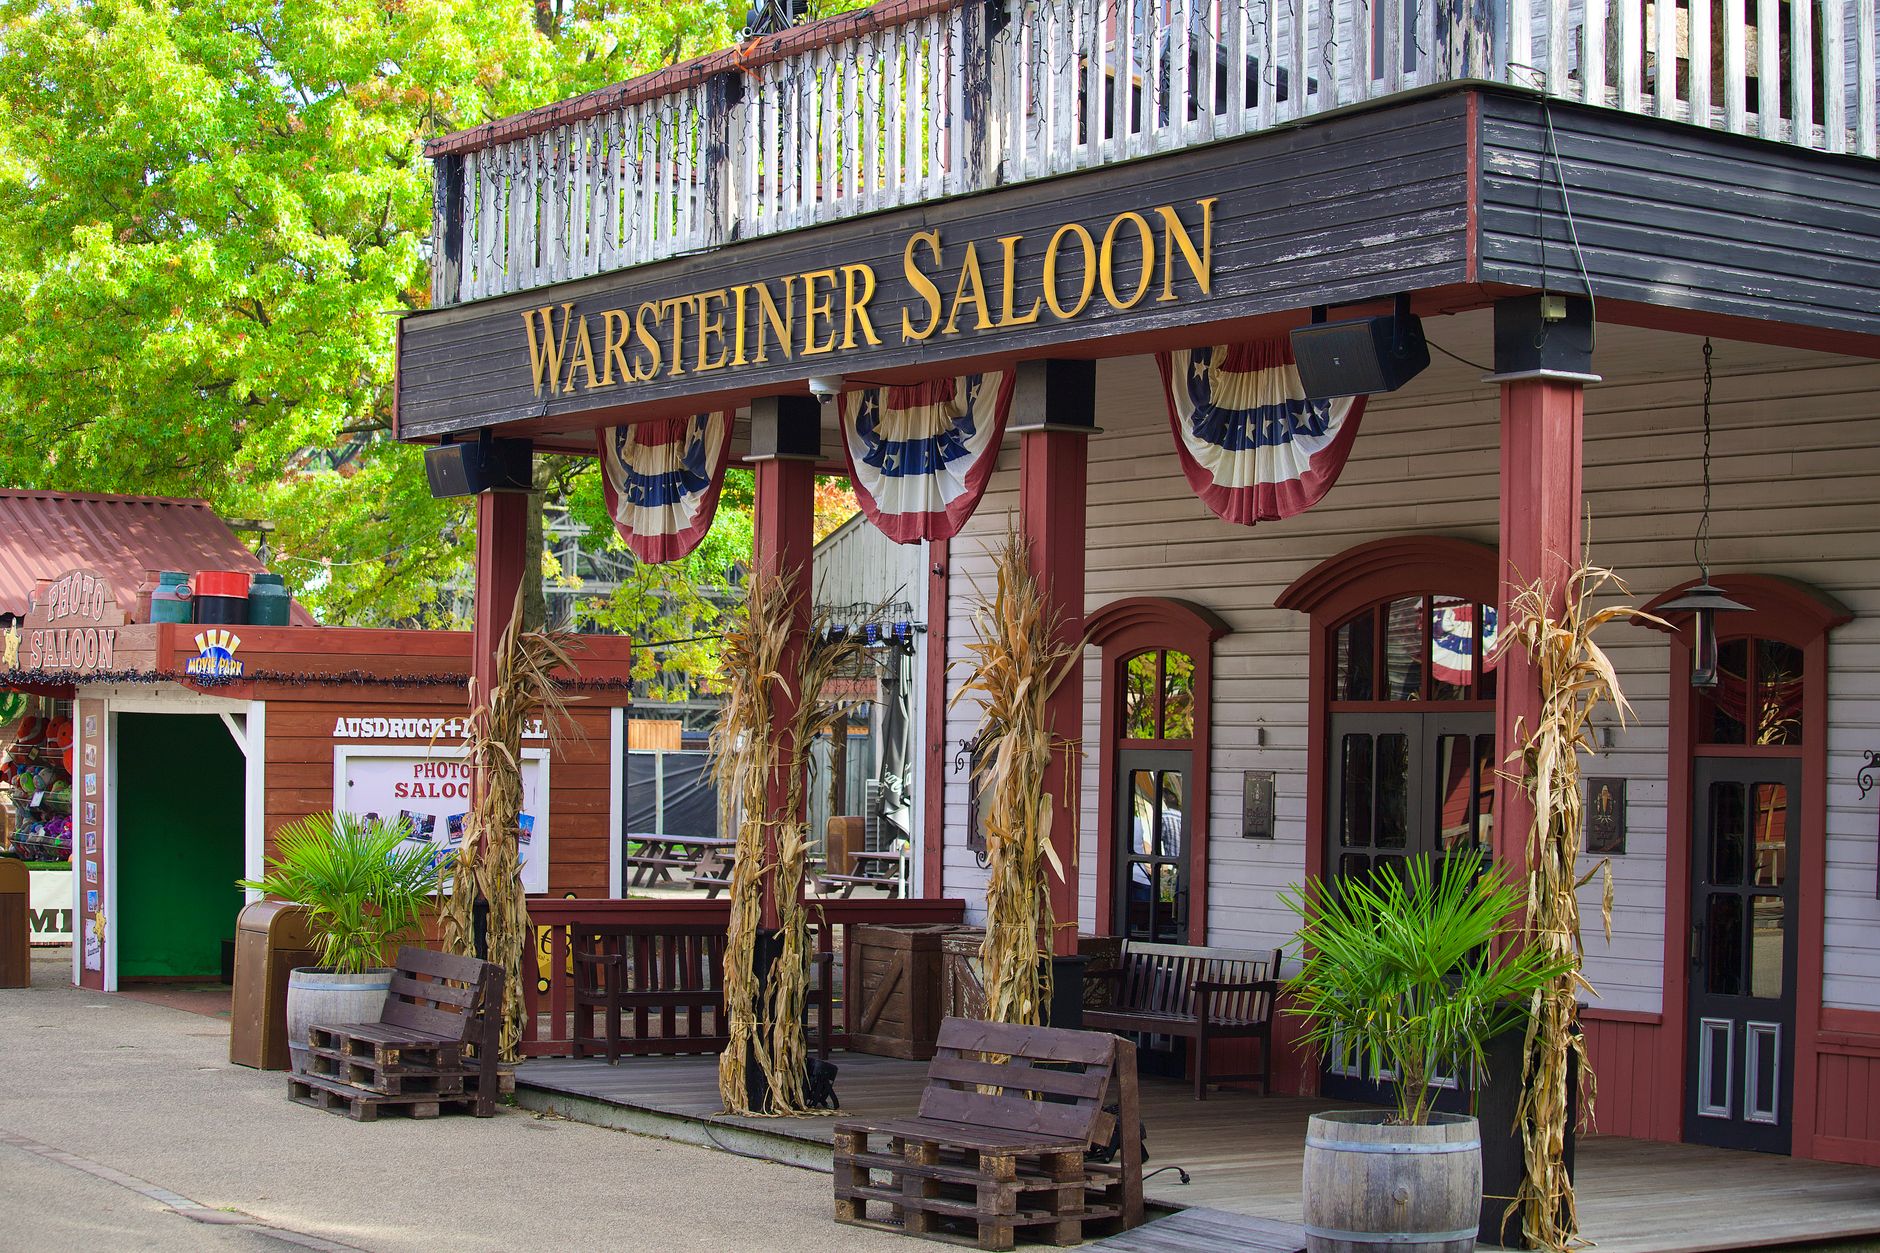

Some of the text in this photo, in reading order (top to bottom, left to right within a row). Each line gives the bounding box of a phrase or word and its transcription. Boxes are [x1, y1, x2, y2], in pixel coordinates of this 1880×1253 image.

[521, 198, 1217, 396] WARSTEINER SALOON
[47, 571, 105, 622] PHOTO
[30, 628, 115, 669] SALOON
[187, 656, 243, 676] MOVIE PARK
[414, 761, 470, 779] PHOTO
[395, 782, 469, 798] SALOO
